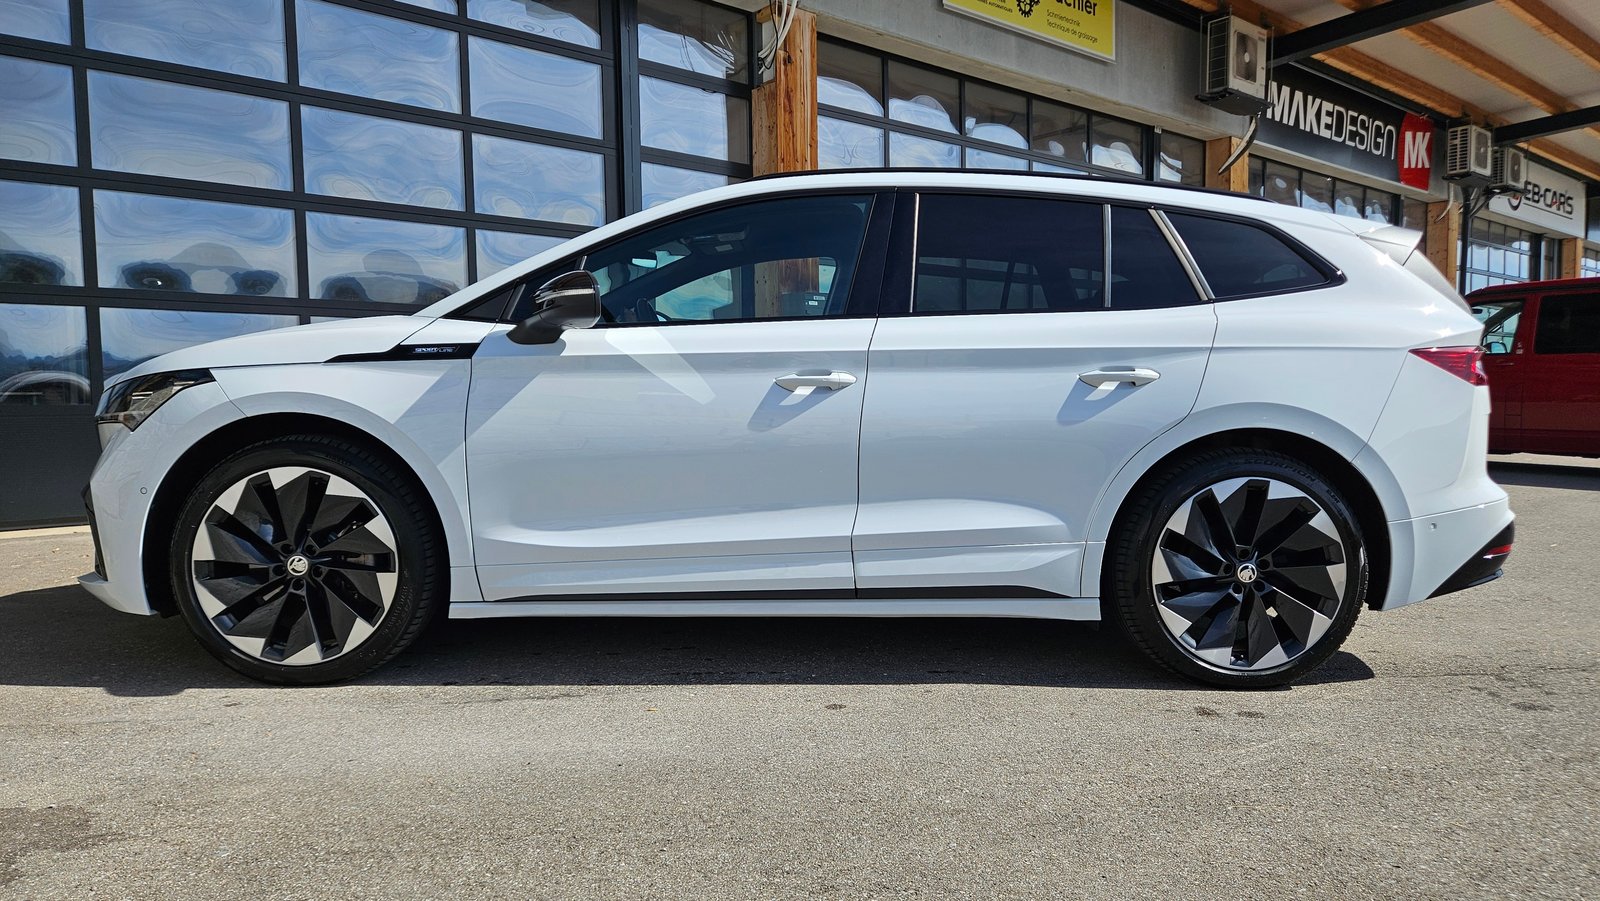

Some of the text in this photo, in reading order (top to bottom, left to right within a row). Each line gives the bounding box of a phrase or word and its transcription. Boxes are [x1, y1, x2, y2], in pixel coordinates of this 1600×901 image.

[1046, 19, 1070, 34] Technique
[1403, 131, 1431, 169] MK
[1244, 458, 1316, 482] SCORPION
